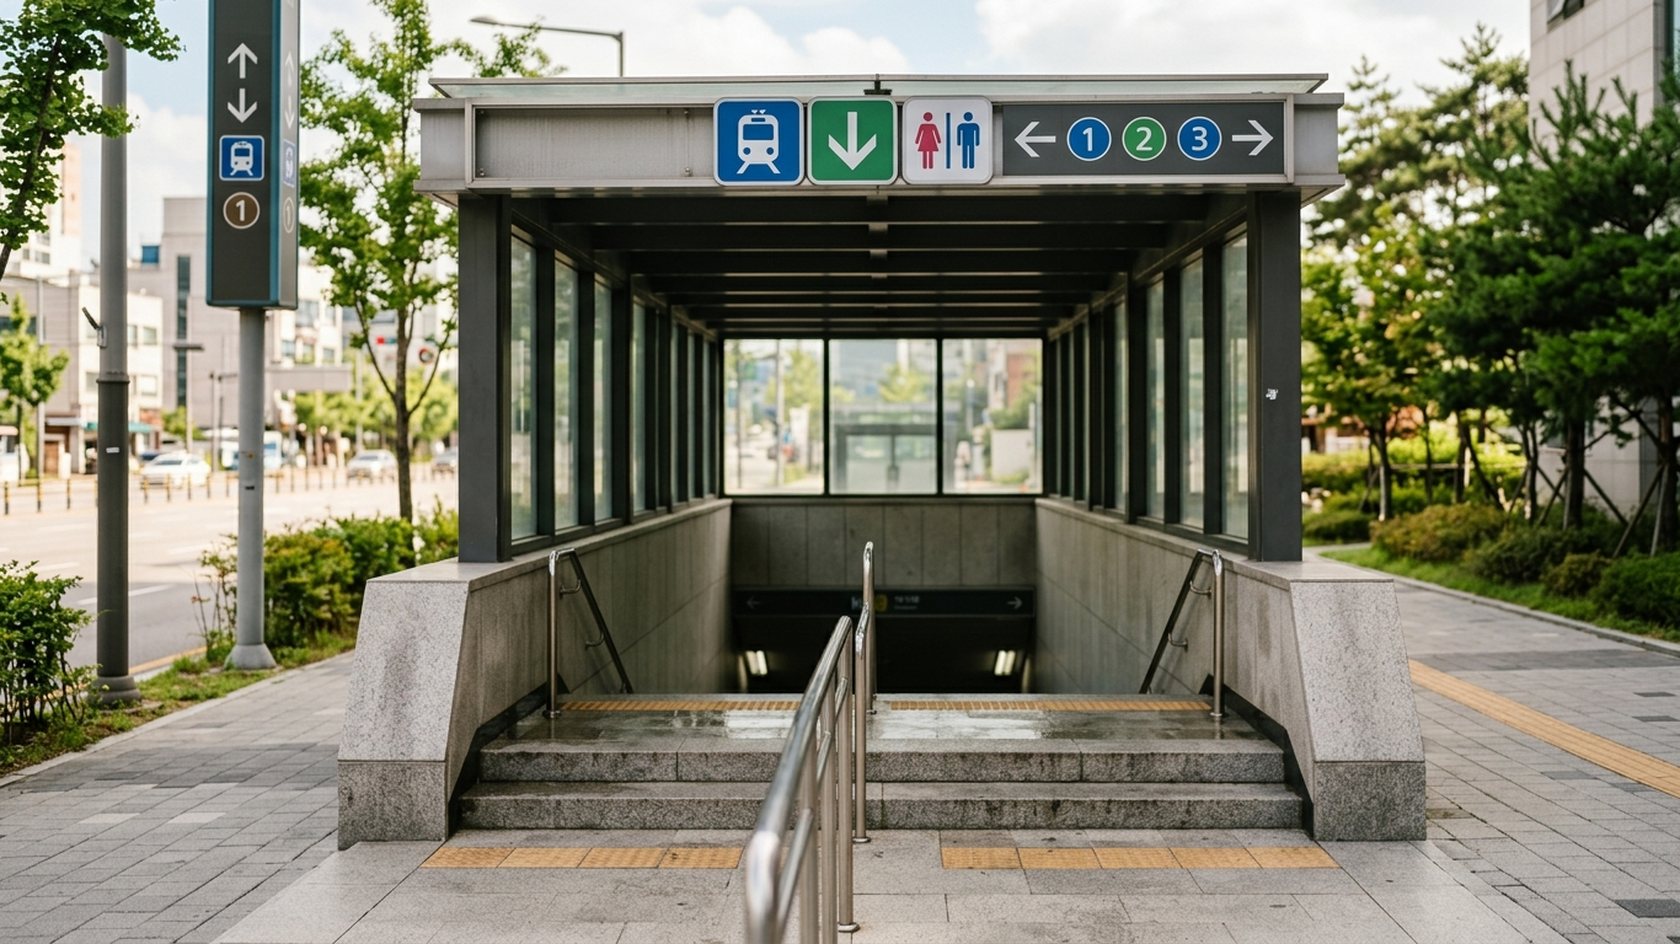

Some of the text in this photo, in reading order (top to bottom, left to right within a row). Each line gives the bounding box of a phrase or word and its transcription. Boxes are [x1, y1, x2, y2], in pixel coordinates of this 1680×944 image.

[1082, 127, 1208, 152] 1 2 3
[235, 199, 245, 221] 1
